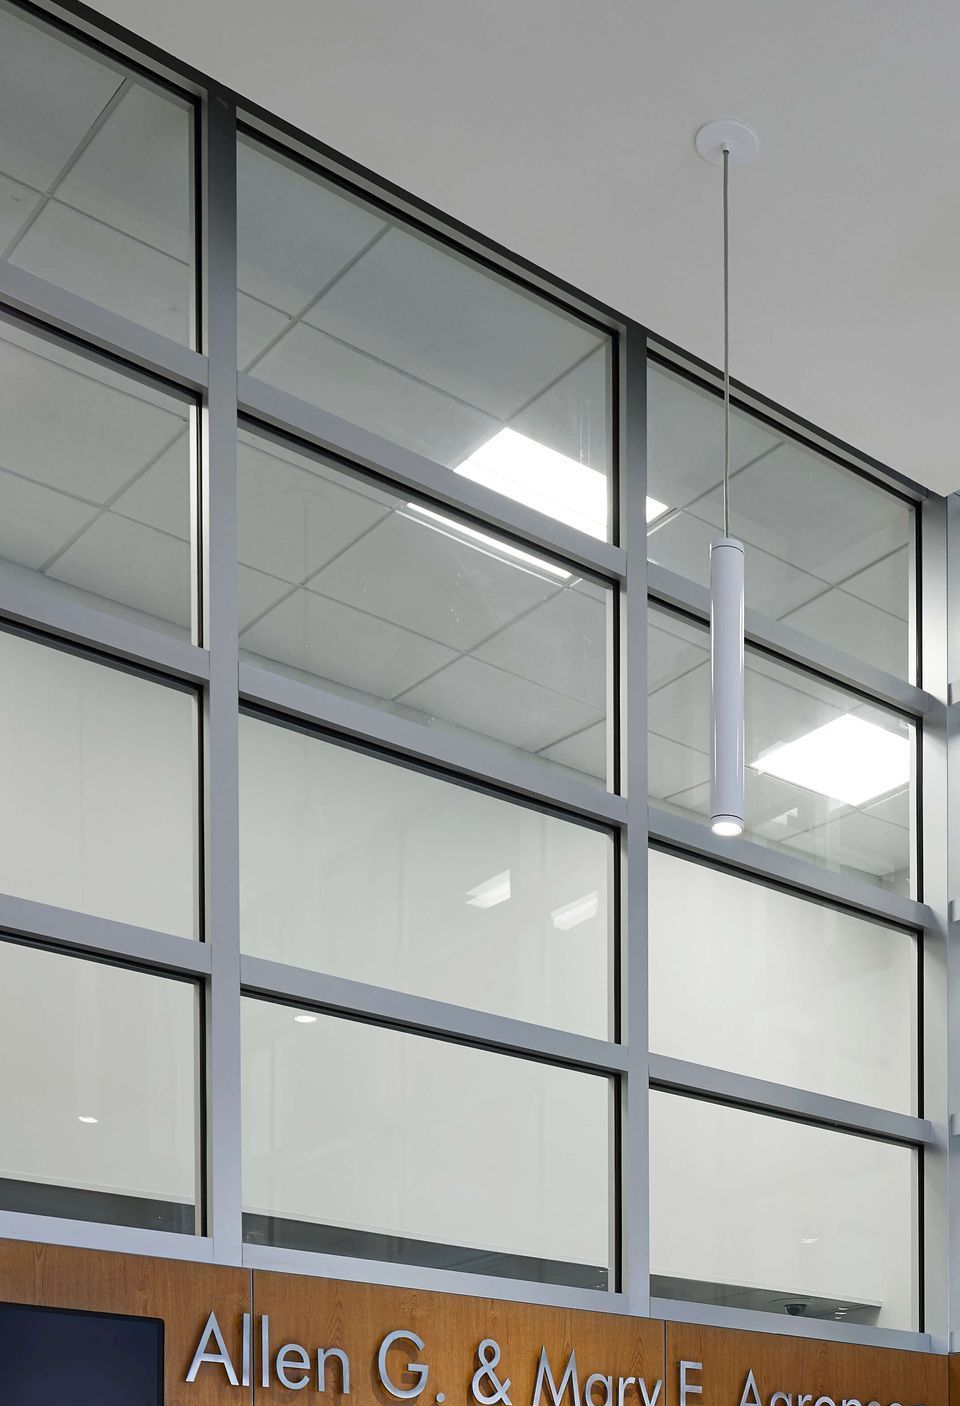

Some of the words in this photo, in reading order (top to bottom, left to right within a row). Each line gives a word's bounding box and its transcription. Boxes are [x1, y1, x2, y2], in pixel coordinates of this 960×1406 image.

[185, 1310, 351, 1395] Allen
[378, 1329, 447, 1404] G.
[471, 1338, 513, 1406] &
